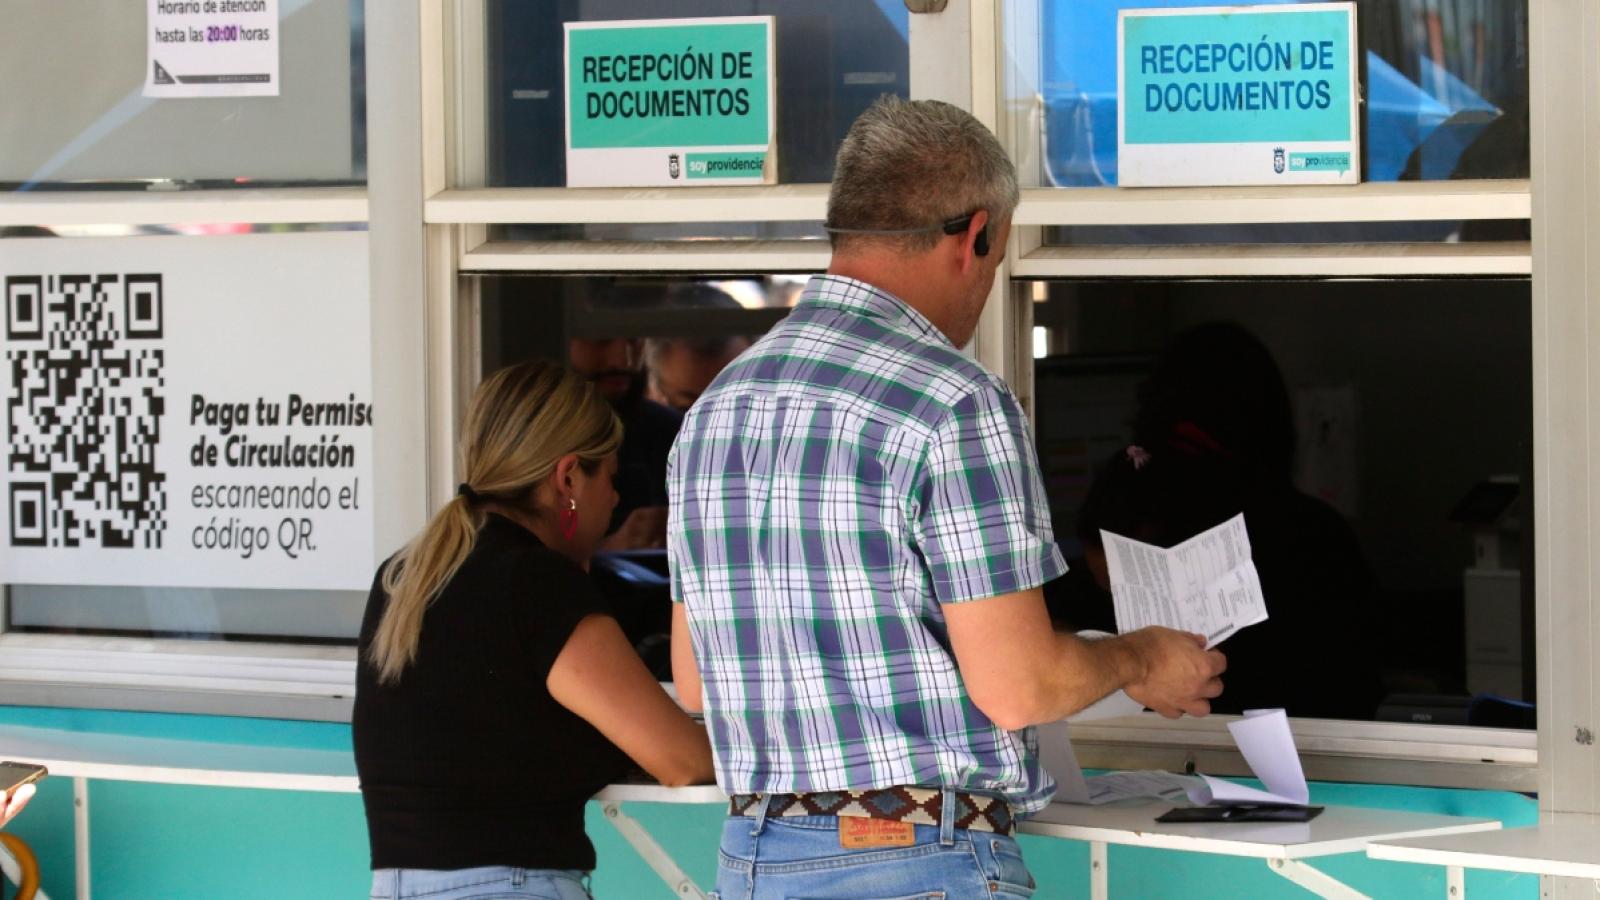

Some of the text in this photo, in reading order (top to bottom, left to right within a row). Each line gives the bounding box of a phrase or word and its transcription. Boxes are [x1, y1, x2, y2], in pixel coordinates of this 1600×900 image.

[157, 0, 200, 14] Horario
[203, 0, 217, 13] de
[155, 25, 270, 42] hasta las 20:00 horas
[583, 46, 753, 83] RECEPCIÓN DE
[1141, 35, 1334, 74] RECEPCIÓN DE
[586, 88, 750, 119] DOCUMENTOS
[1145, 79, 1331, 112] DOCUMENTOS
[190, 394, 249, 435] Paga
[255, 397, 280, 426] tu
[190, 434, 355, 468] de Circulación
[191, 477, 359, 510] escaneando el
[191, 516, 317, 559] código QR.
